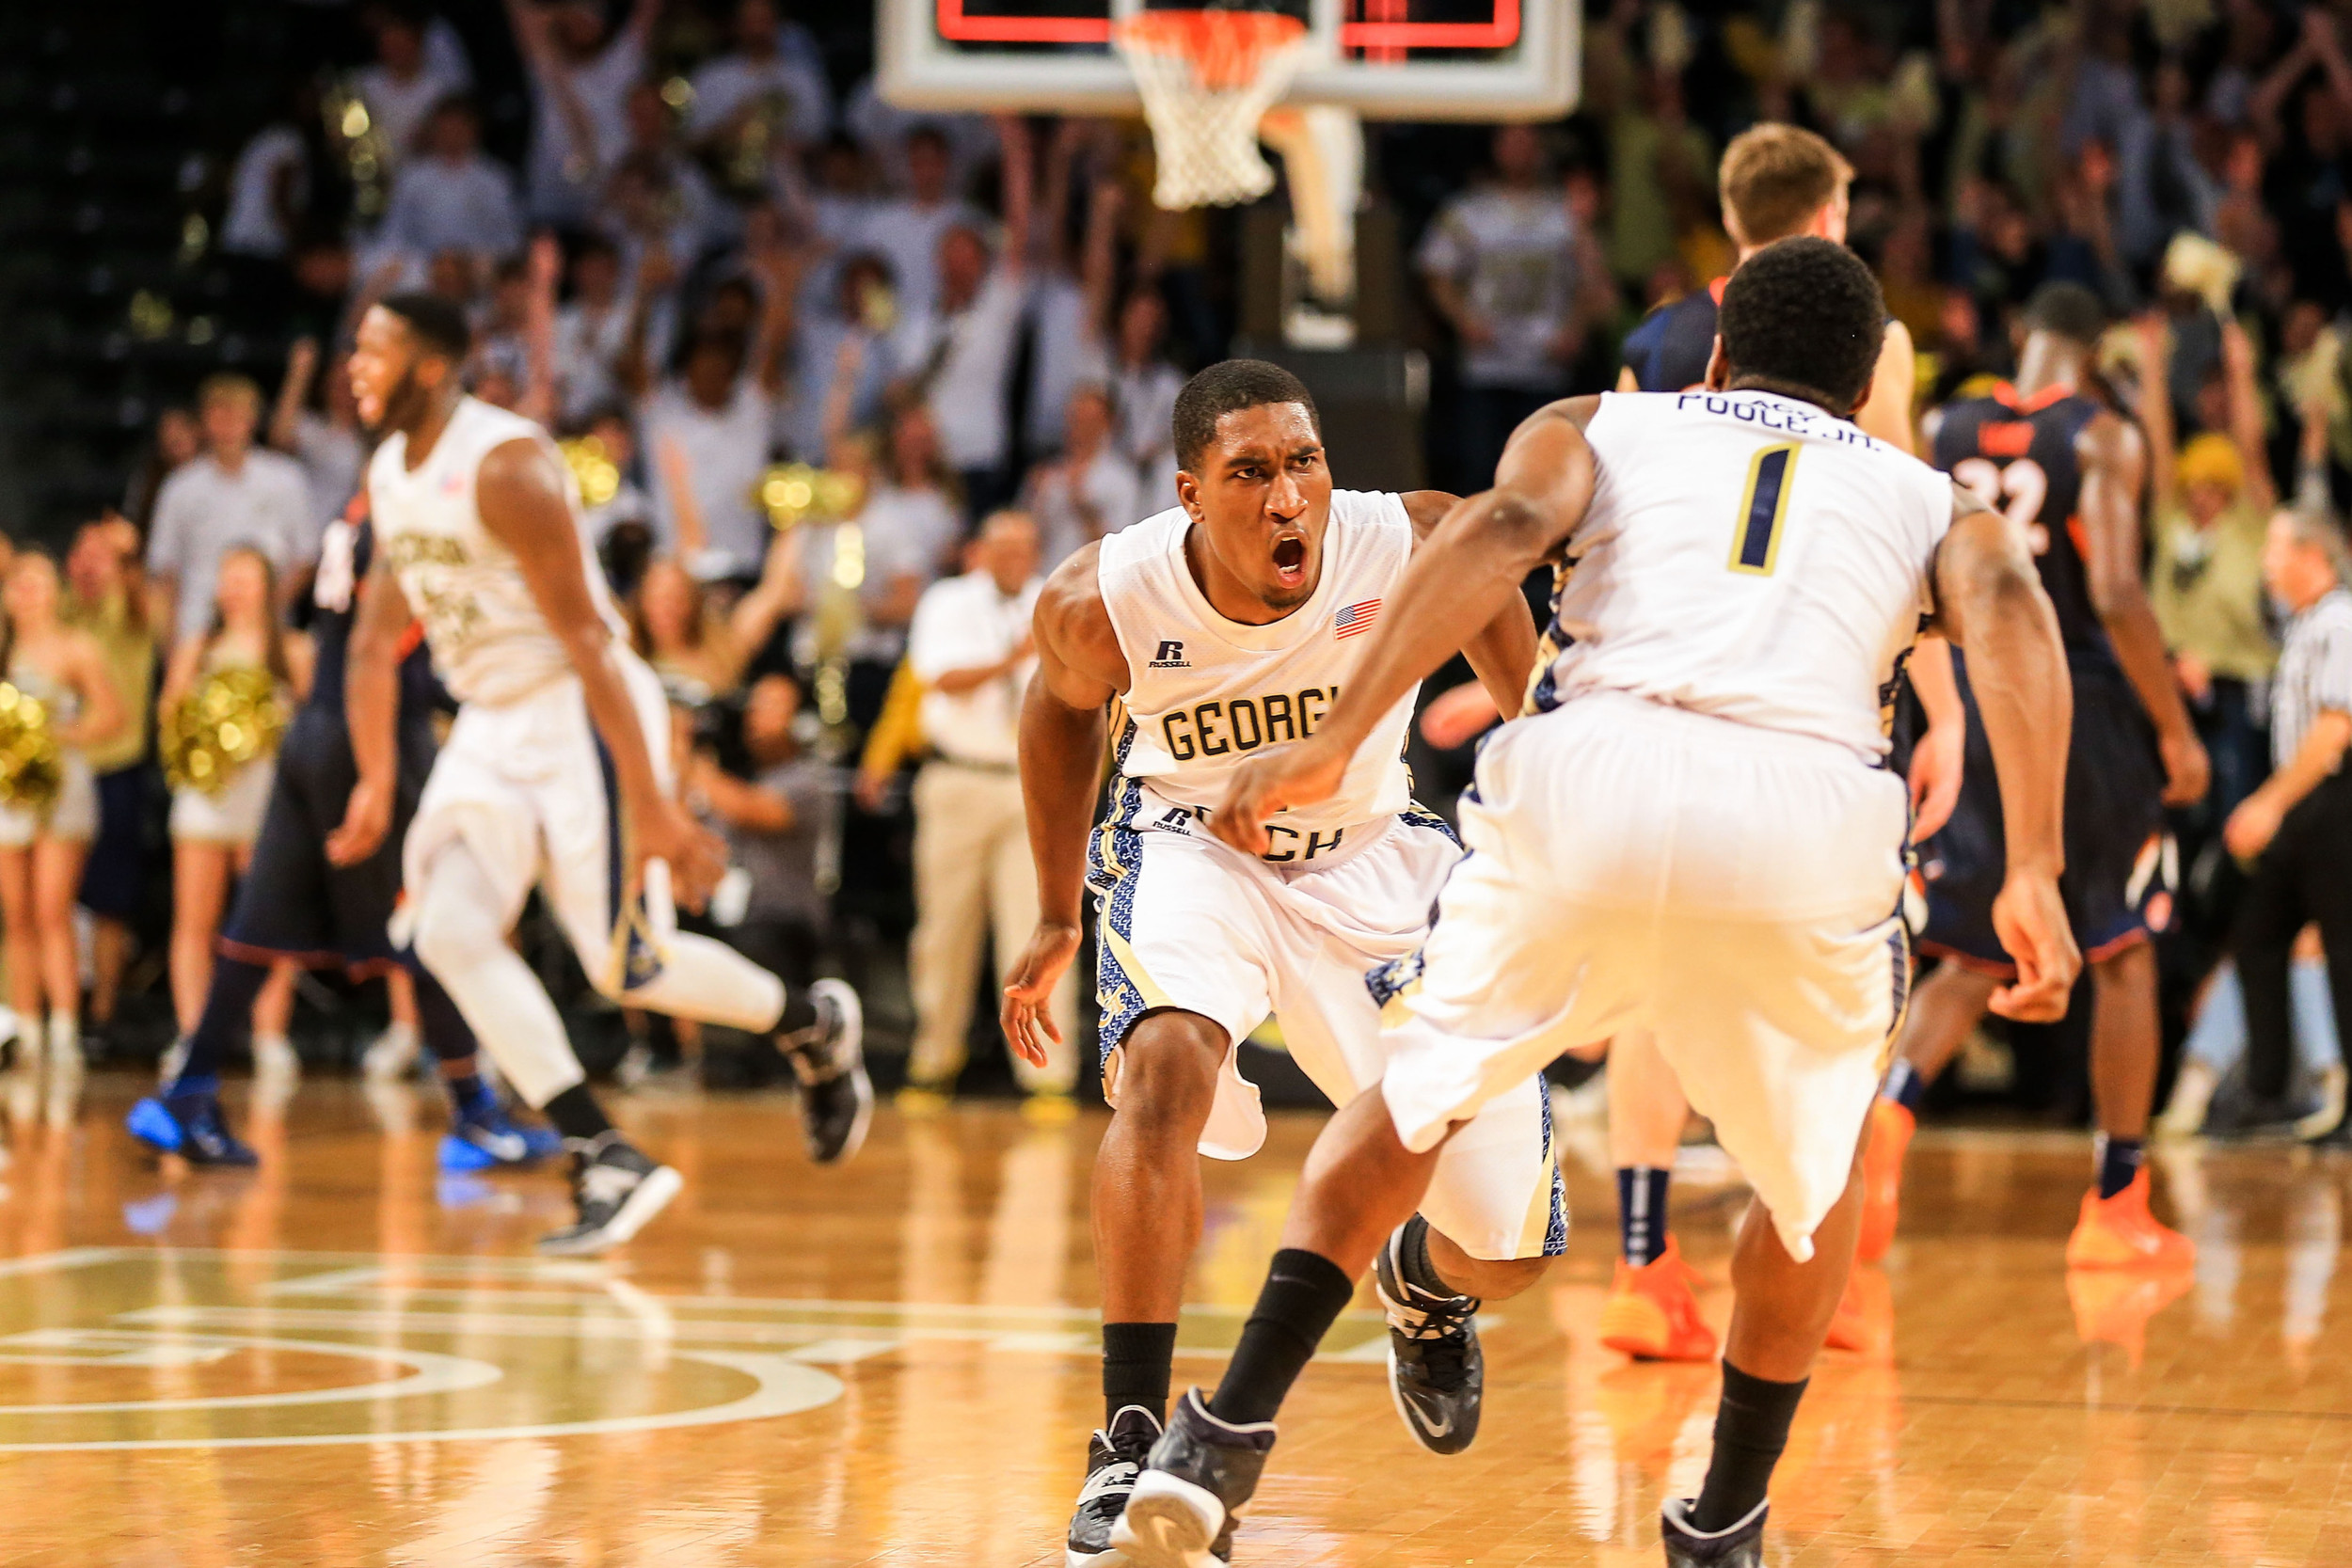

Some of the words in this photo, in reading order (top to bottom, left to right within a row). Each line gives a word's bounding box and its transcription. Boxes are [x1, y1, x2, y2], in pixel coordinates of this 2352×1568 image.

[1726, 439, 1804, 578] 1
[1148, 660, 1192, 669] RUSSELL
[1152, 820, 1192, 837] RUSSELL
